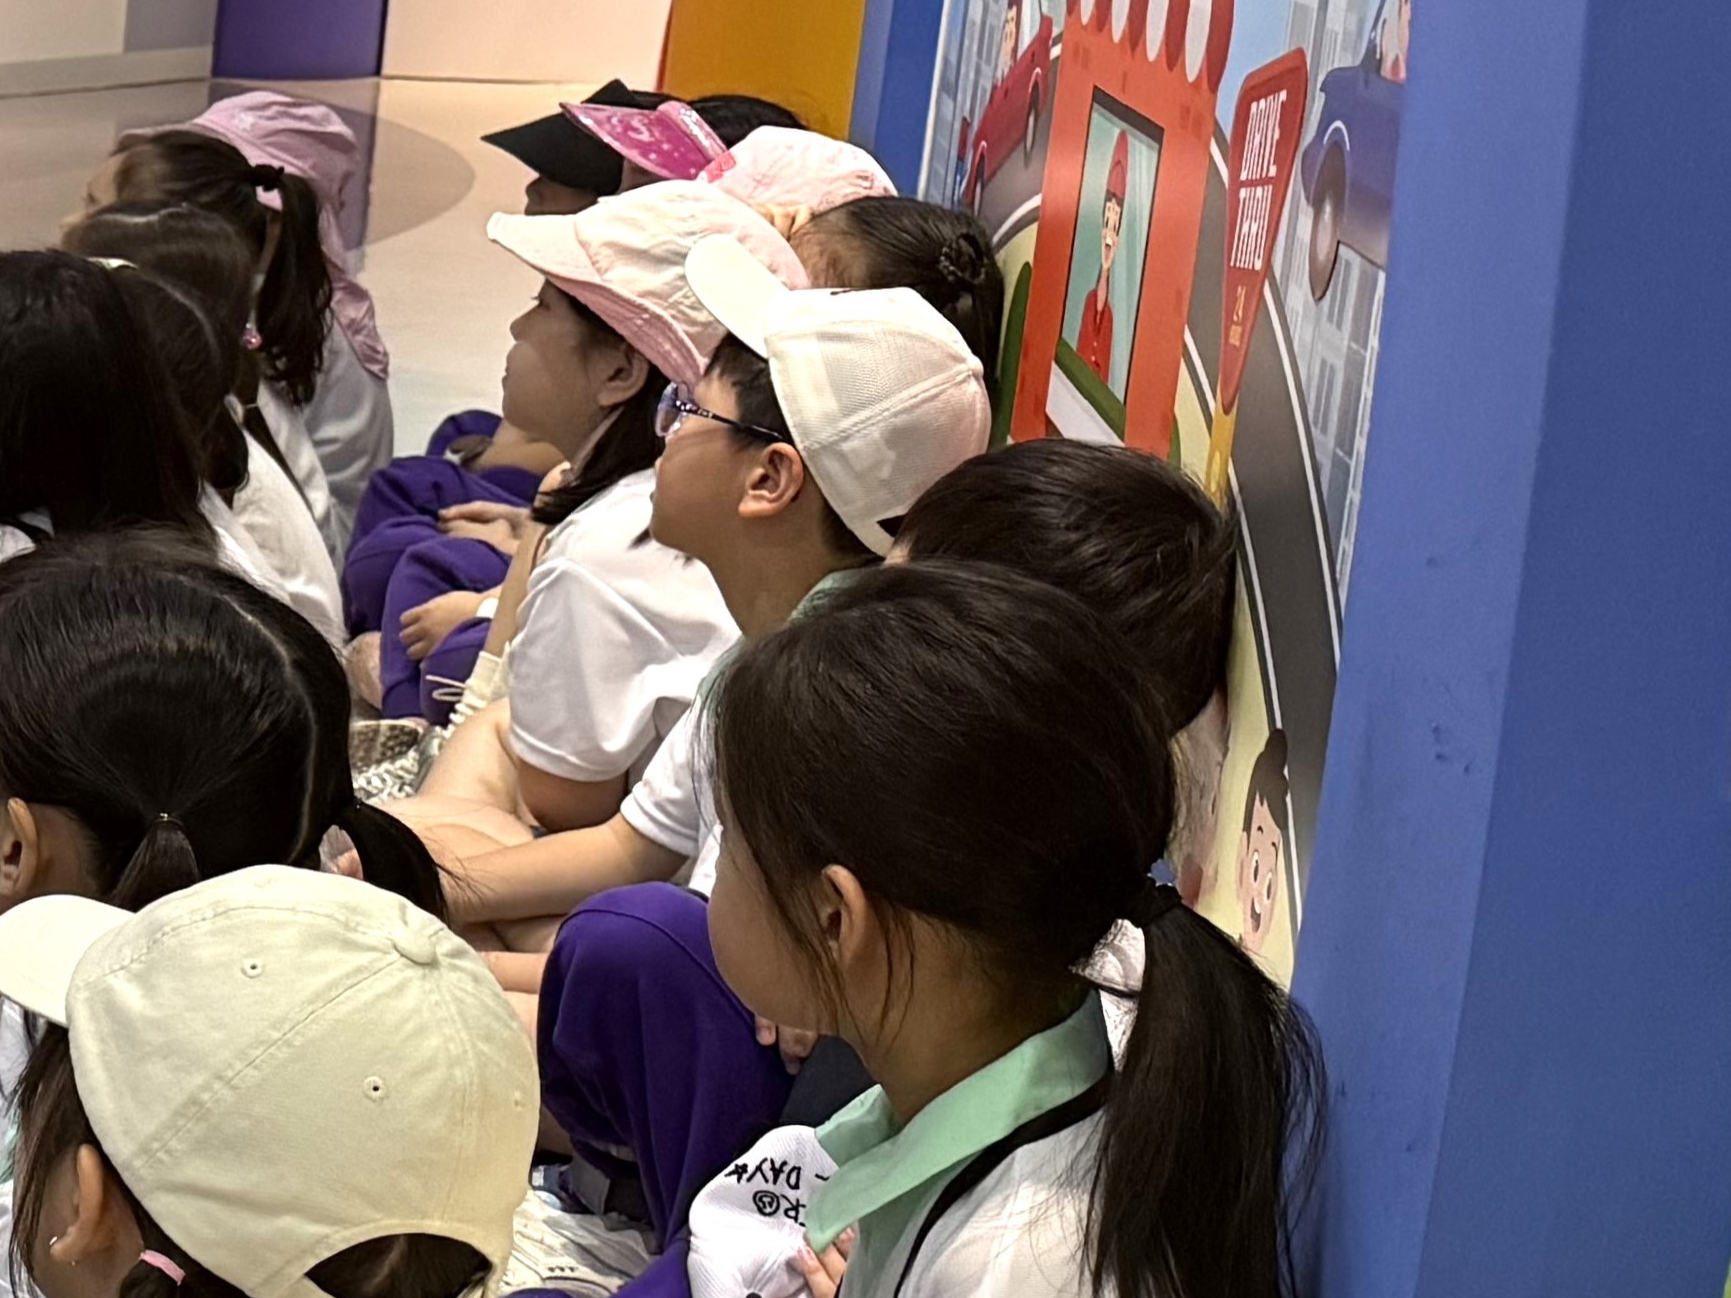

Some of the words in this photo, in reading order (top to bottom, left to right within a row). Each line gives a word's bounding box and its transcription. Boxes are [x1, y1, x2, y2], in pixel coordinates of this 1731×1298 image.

[1240, 88, 1287, 182] DRIVE
[1230, 185, 1272, 271] THRU
[747, 1157, 802, 1191] DAY
